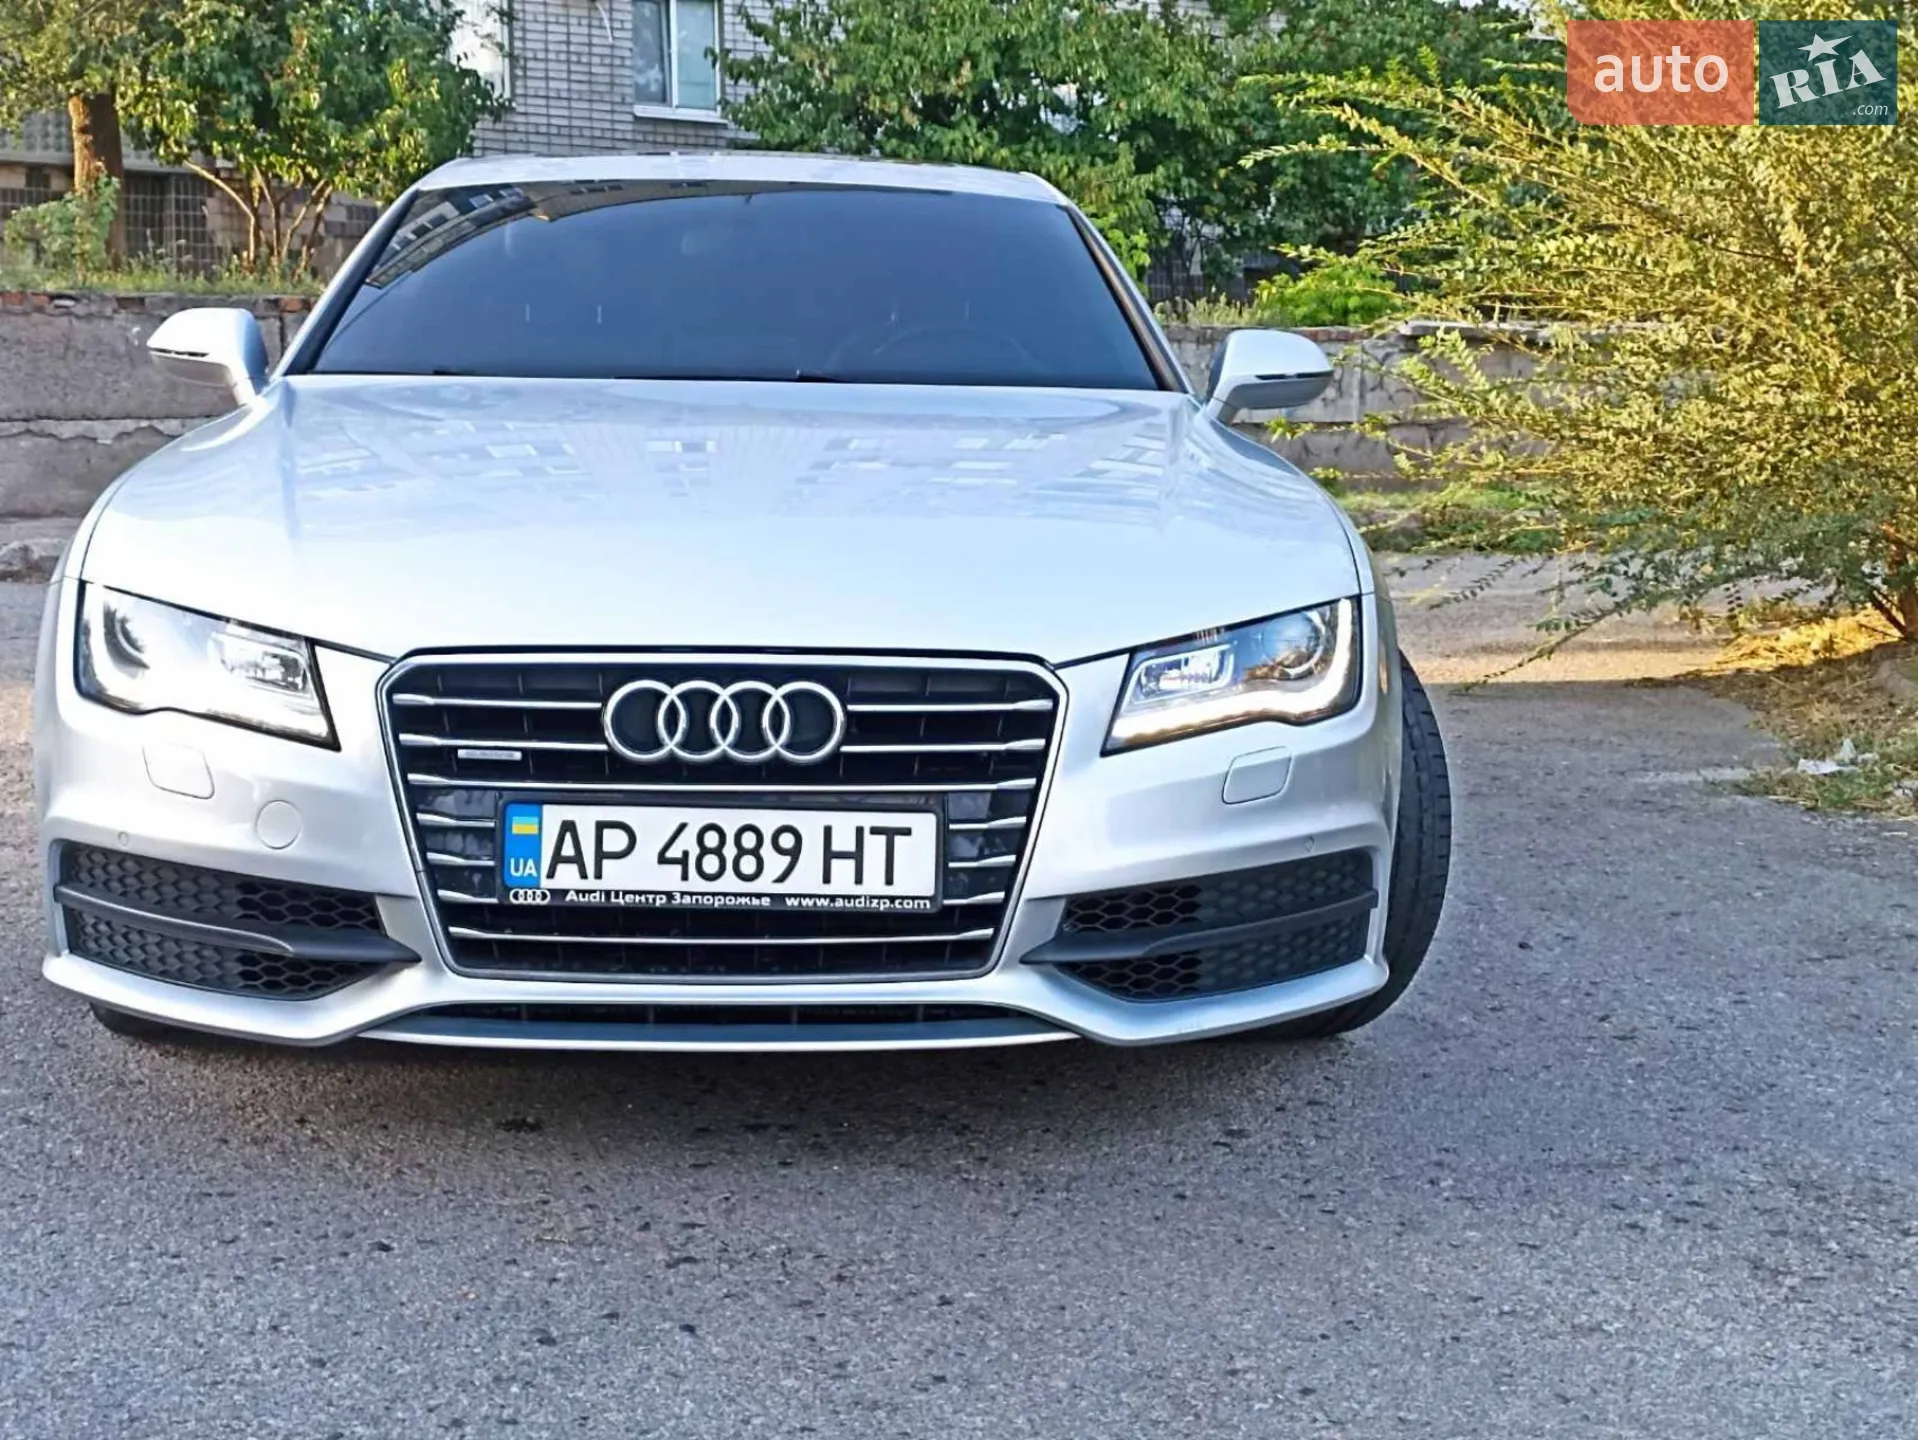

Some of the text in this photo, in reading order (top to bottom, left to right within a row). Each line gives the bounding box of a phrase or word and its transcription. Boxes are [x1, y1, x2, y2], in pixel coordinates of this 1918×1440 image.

[545, 819, 912, 885] AP 4889 HT
[510, 858, 538, 877] UA
[565, 889, 931, 910] Audi Центр Запорожье www.audizp.com
